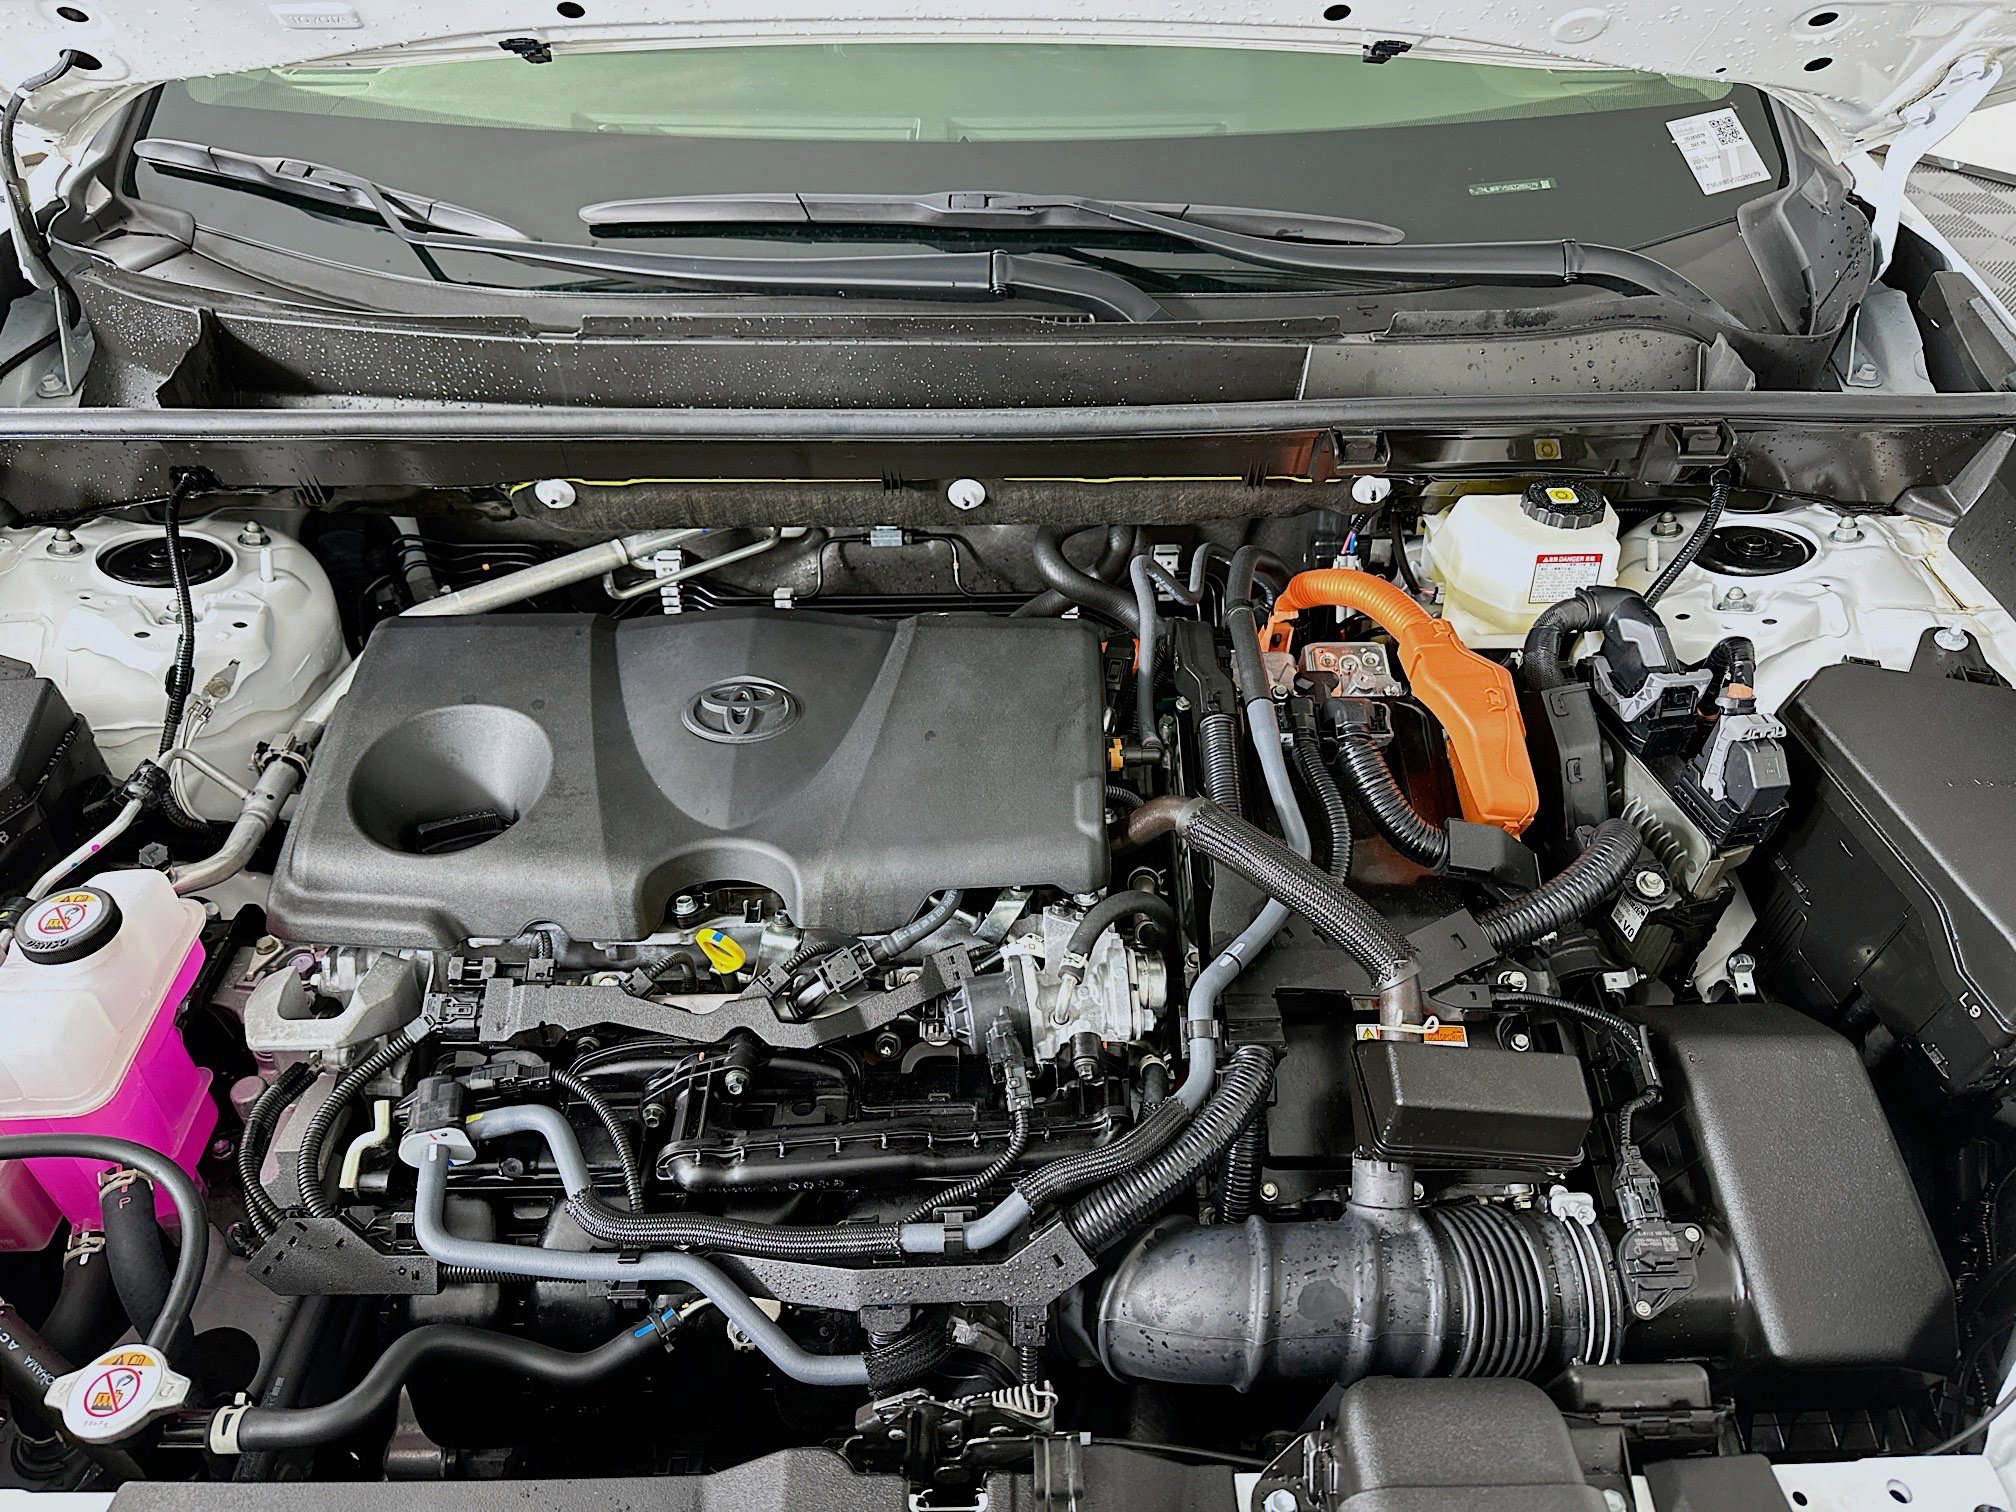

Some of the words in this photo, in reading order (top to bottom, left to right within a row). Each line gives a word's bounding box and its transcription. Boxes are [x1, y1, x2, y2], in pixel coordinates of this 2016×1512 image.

[288, 15, 349, 24] TOYOTA
[25, 939, 68, 949] DENSO
[1958, 991, 1982, 1018] L9
